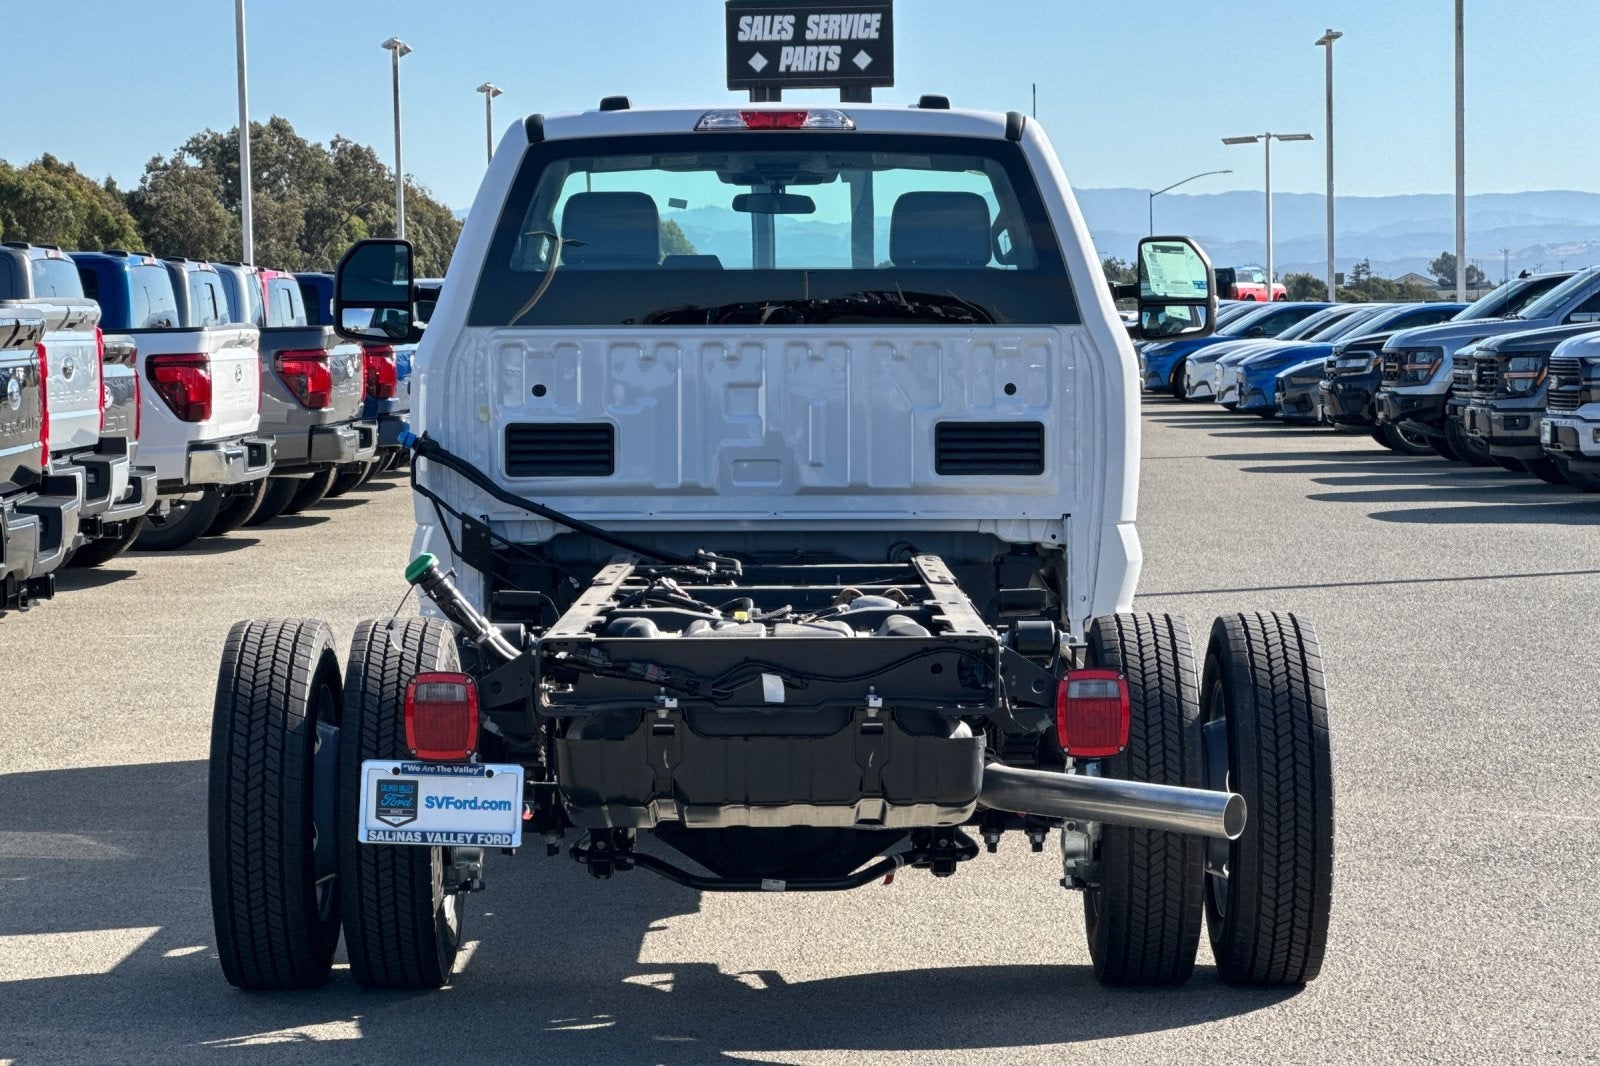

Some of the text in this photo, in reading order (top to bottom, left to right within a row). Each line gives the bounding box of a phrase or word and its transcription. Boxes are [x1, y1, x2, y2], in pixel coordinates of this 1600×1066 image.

[737, 13, 882, 42] SALES SERVICE
[778, 45, 842, 72] PARTS
[436, 766, 452, 774] The
[381, 793, 414, 807] Ford
[425, 796, 512, 811] SVFord.com
[369, 831, 511, 845] SALINAS VALLEY FORD
